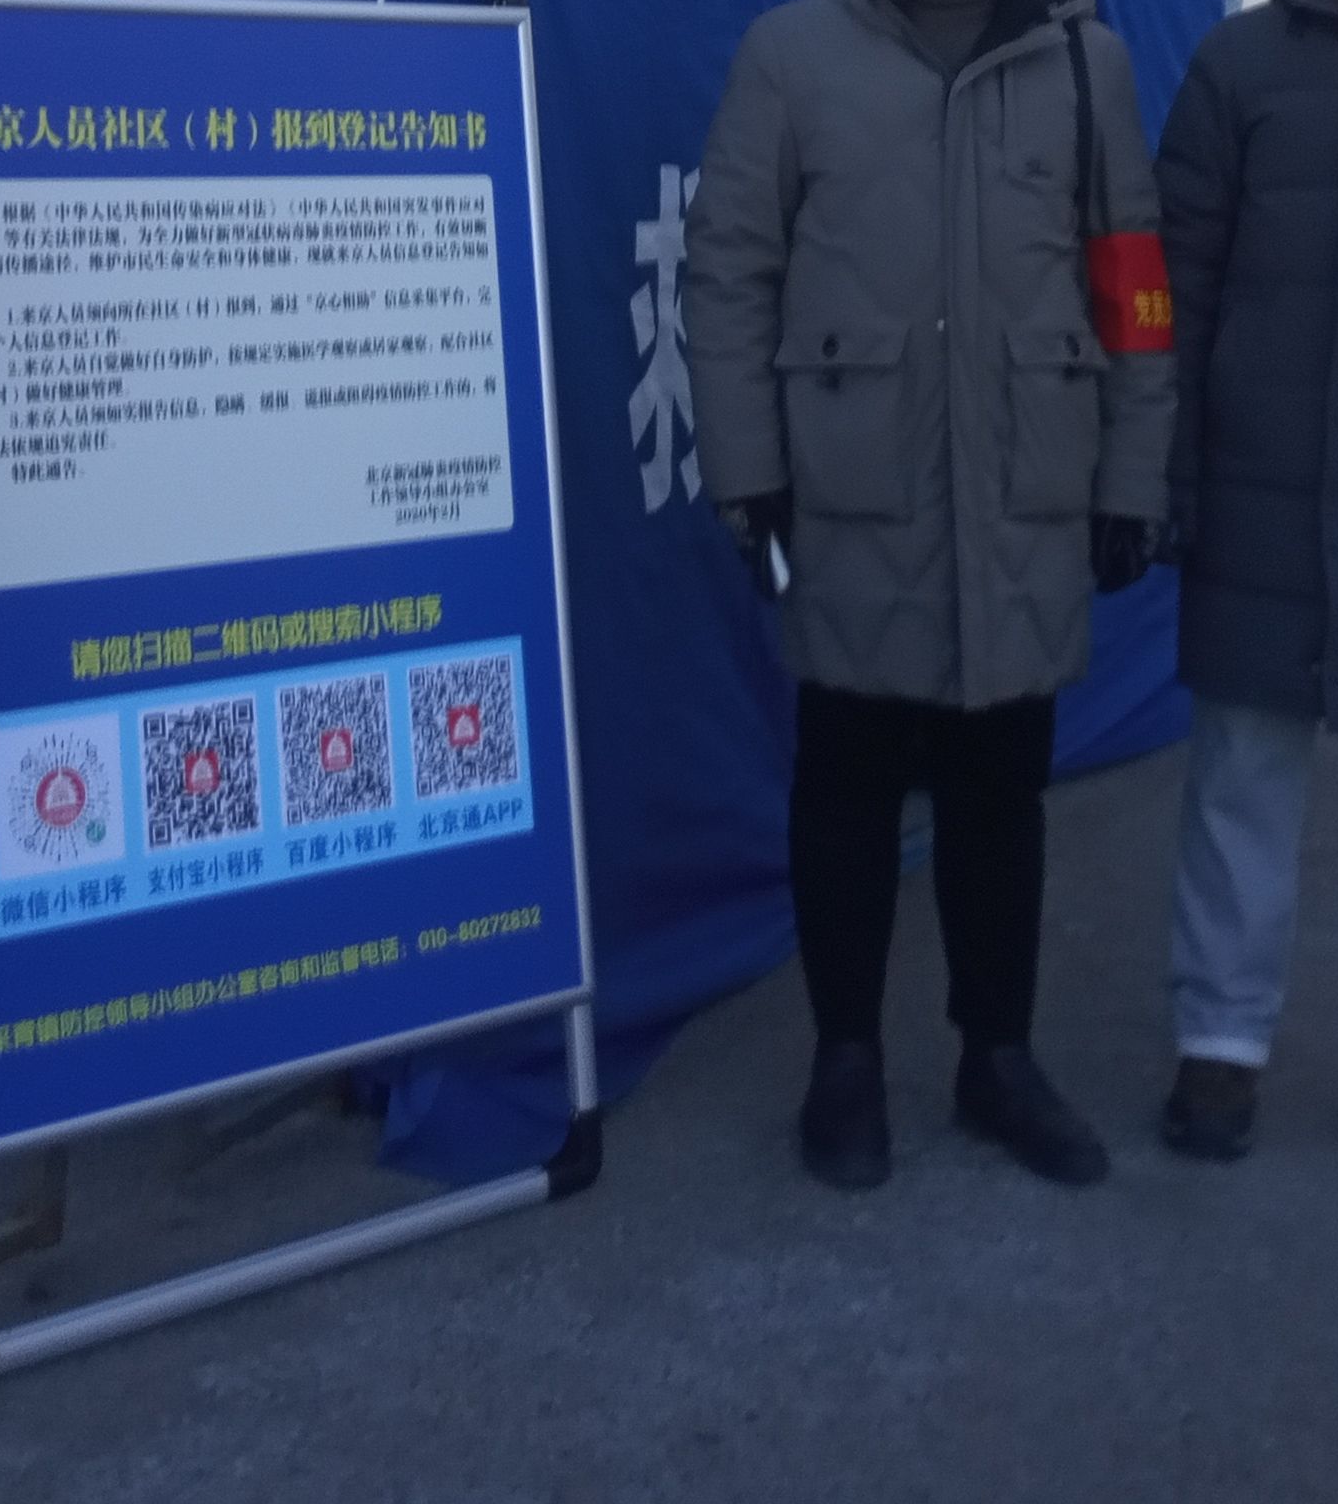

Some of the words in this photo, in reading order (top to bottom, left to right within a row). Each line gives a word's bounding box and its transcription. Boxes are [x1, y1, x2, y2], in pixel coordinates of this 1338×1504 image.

[71, 594, 443, 680] 请您扫描二维码或搜索小程序
[285, 821, 398, 867] 百度小程序
[417, 797, 524, 841] 北京通APP
[147, 846, 265, 896] 支付宝小程序
[0, 873, 128, 926] 微信小程序
